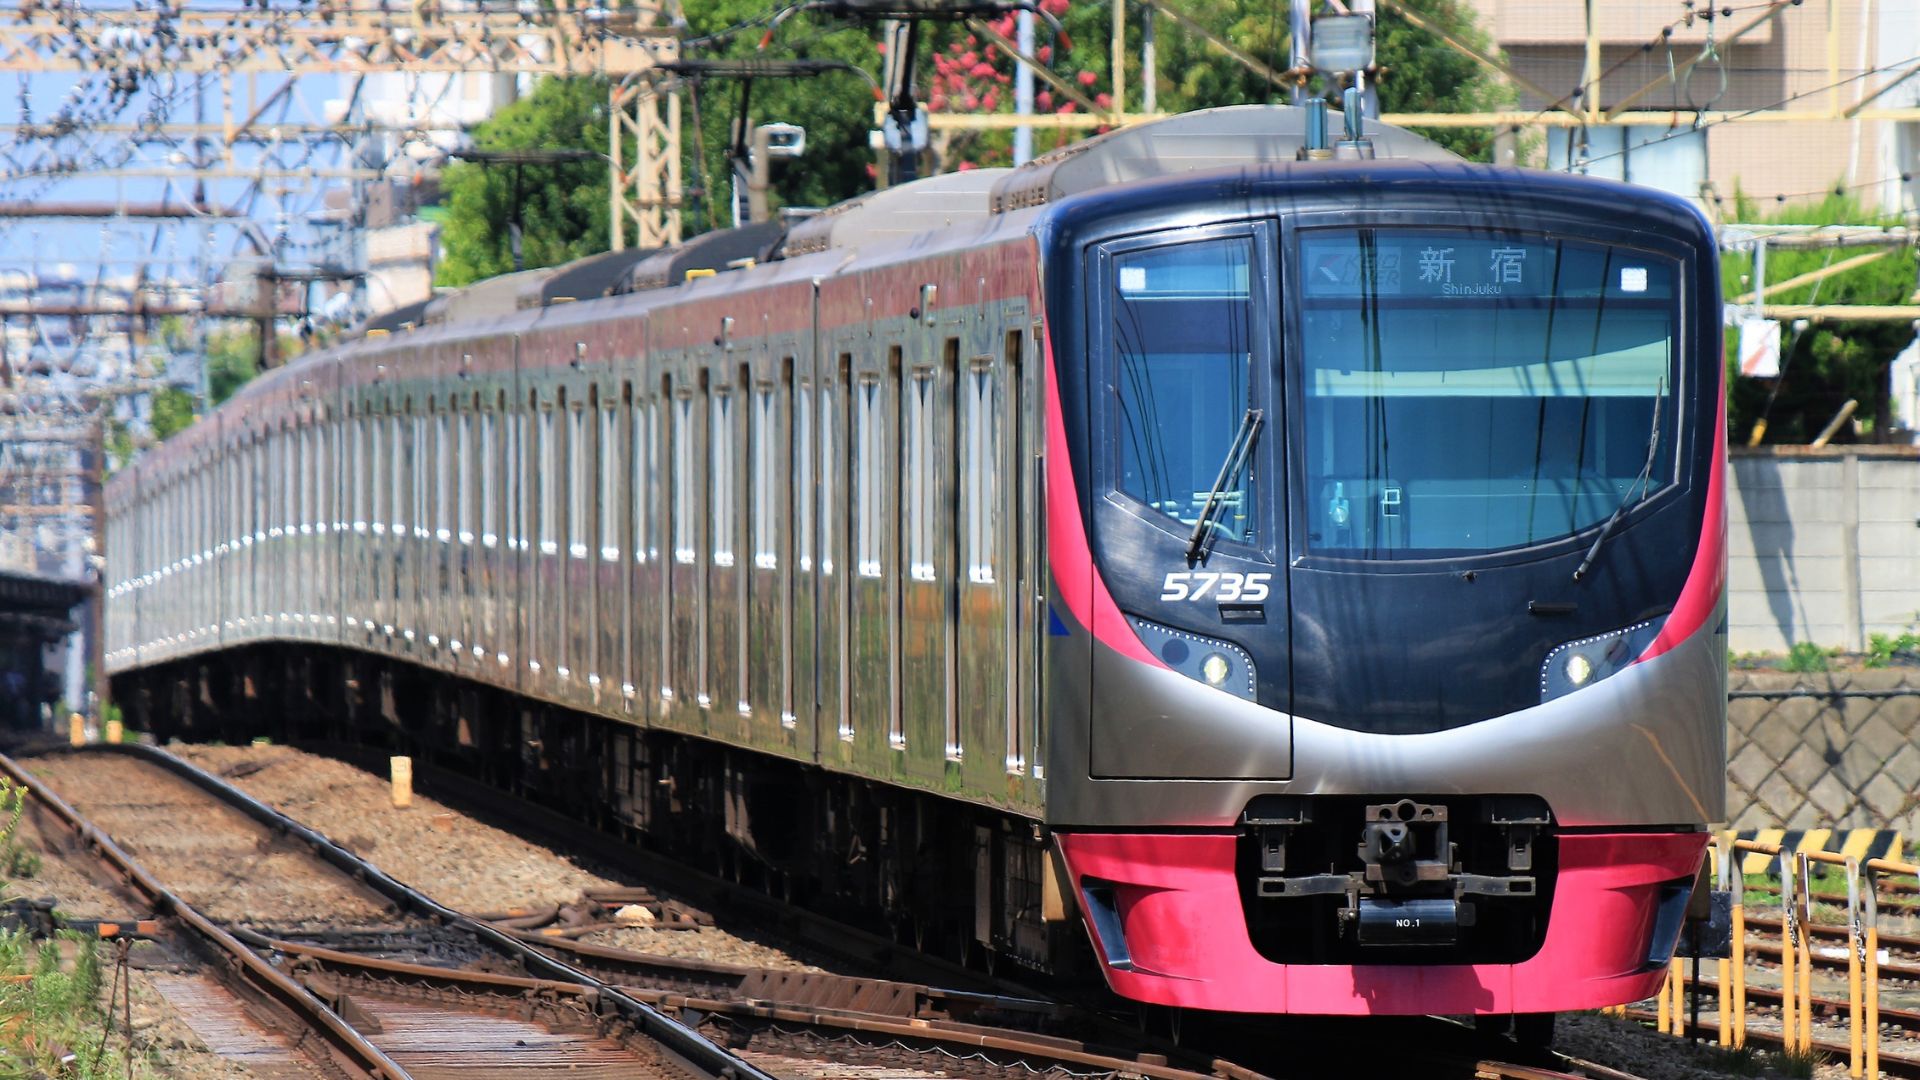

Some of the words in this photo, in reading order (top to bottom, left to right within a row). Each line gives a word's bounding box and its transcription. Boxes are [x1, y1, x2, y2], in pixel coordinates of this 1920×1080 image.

[1419, 246, 1526, 282] 新宿
[1341, 270, 1400, 287] LIER
[1160, 572, 1272, 602] 5735
[1395, 918, 1420, 928] NO.1
